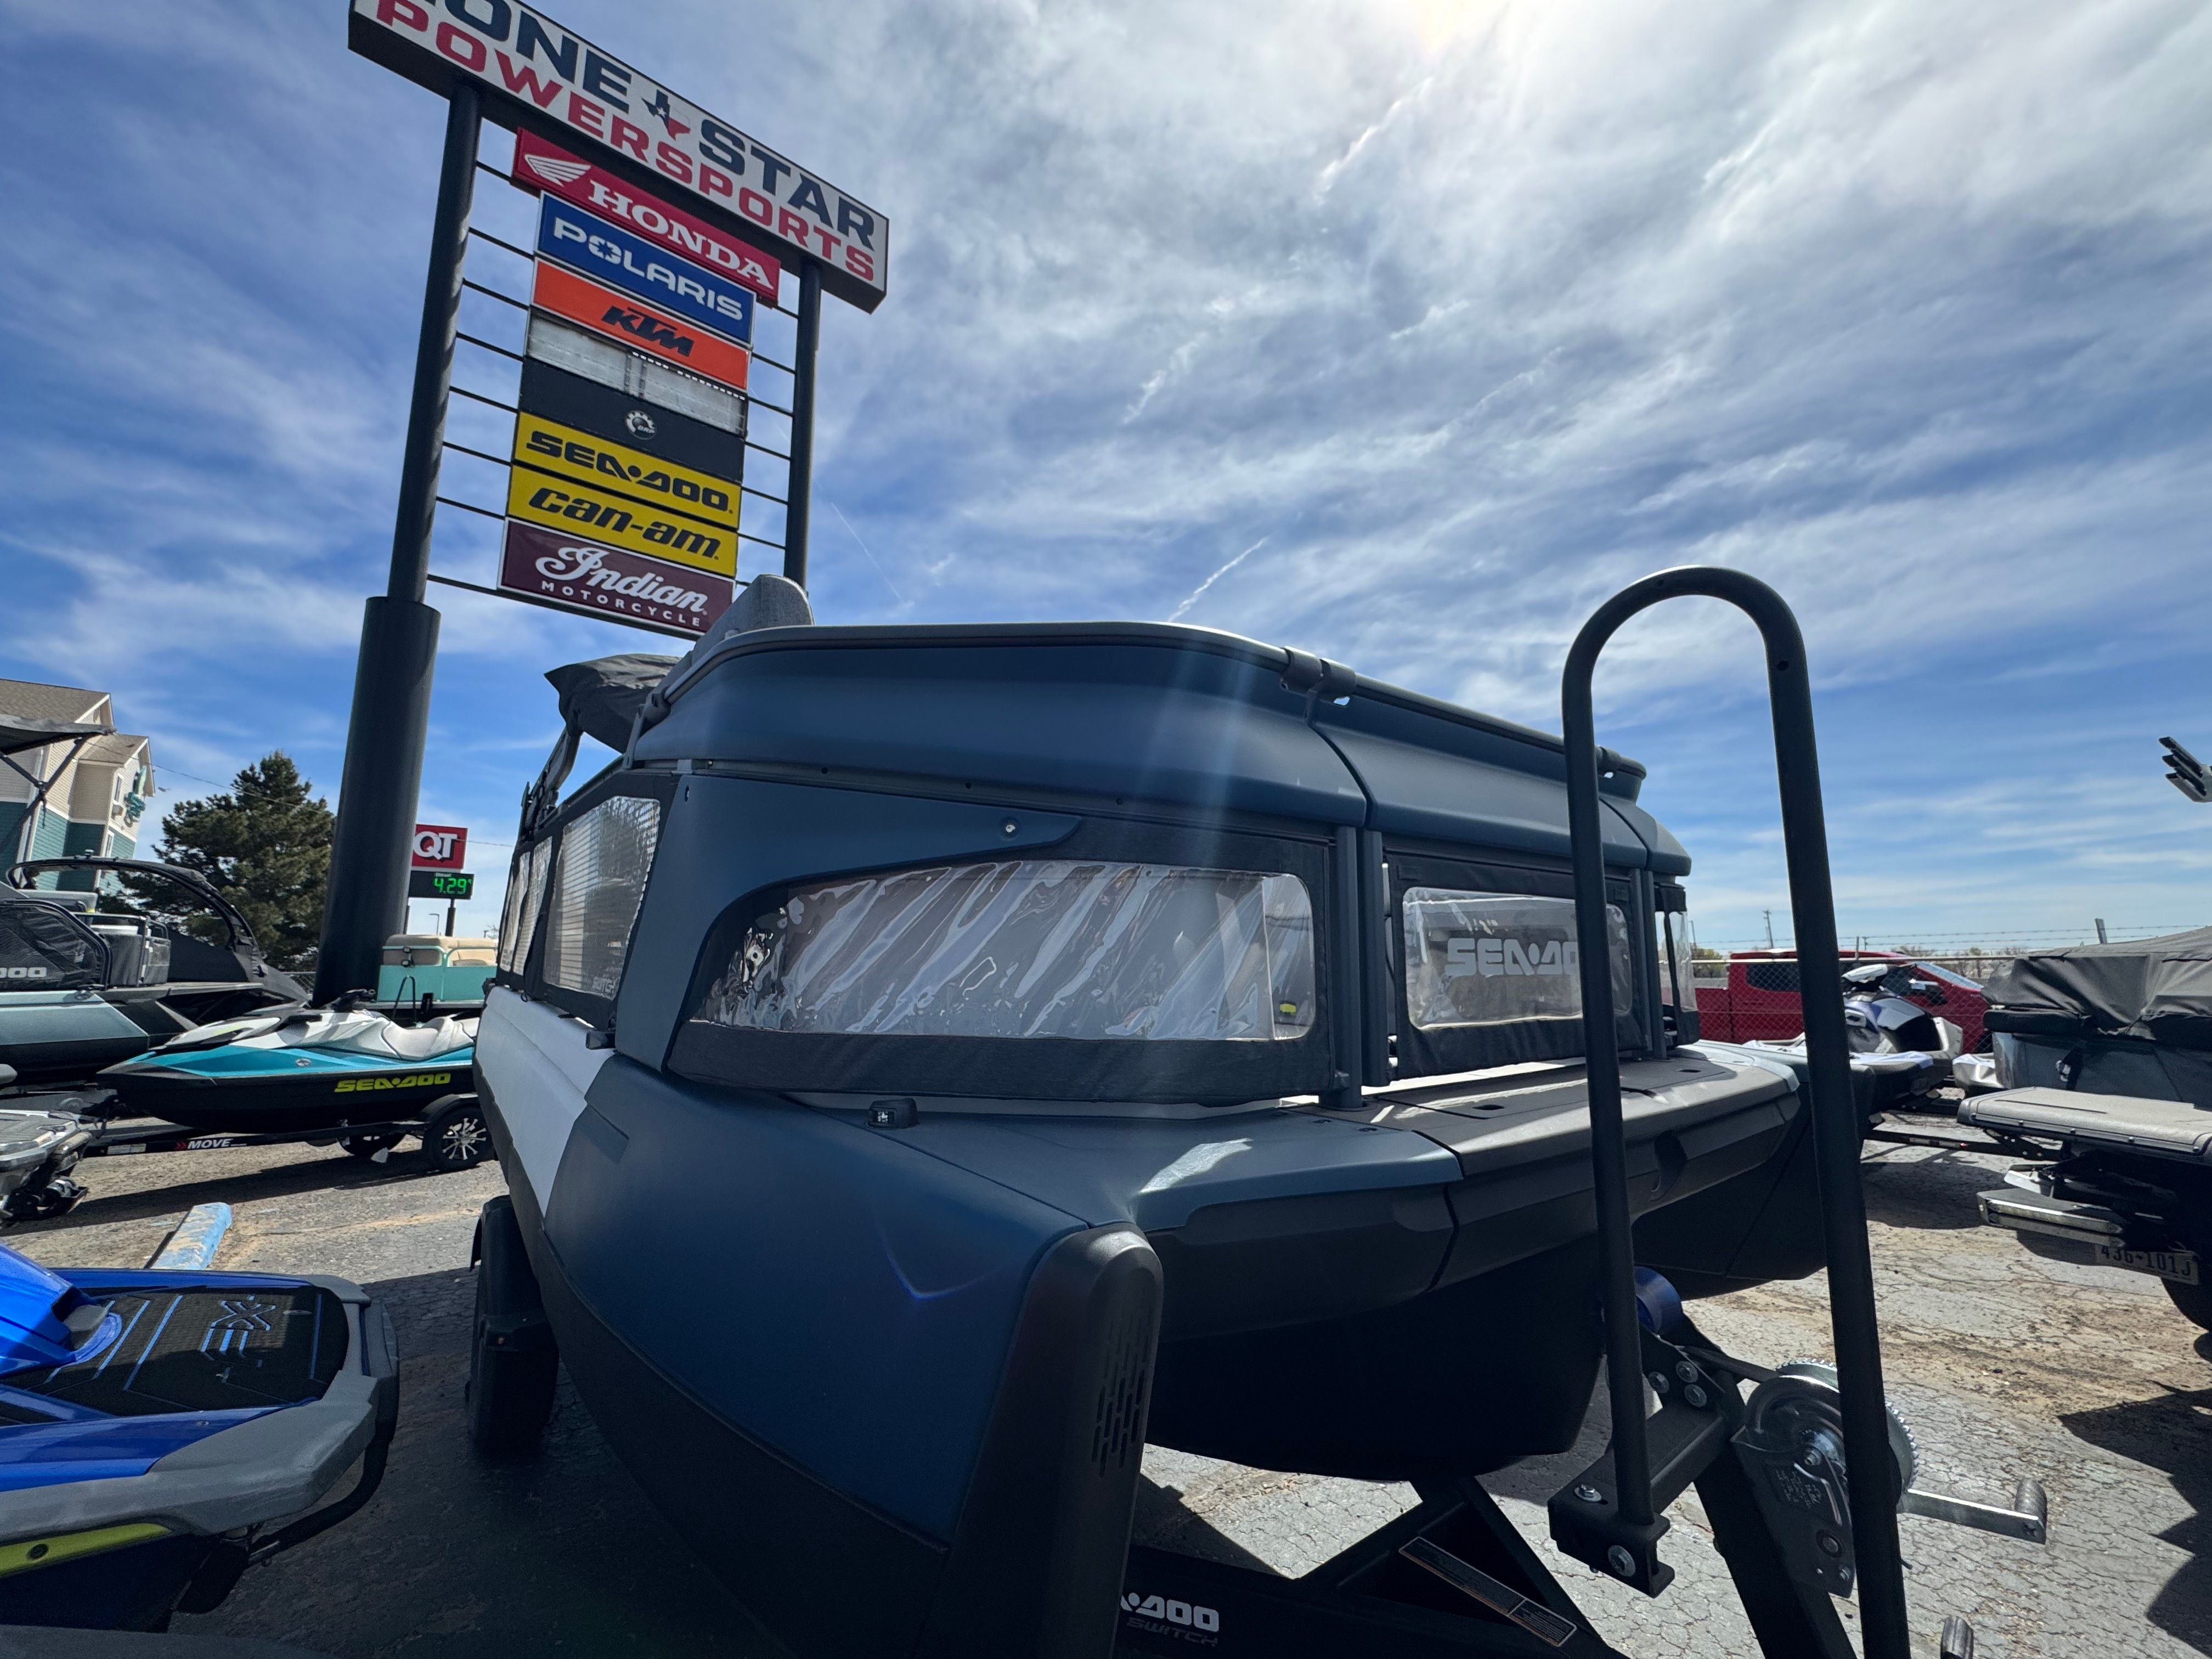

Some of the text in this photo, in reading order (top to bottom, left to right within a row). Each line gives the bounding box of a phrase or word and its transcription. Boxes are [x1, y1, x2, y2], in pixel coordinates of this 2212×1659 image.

[376, 0, 874, 281] POWERSPORTS
[422, 0, 874, 252] ONE STAR
[588, 179, 774, 290] HONDA
[554, 217, 743, 320] POLARIS
[601, 305, 696, 357] KTM
[535, 547, 708, 613] Indian
[541, 580, 701, 627] MOTORCYCLE
[413, 831, 458, 860] QT
[187, 1138, 235, 1150] MOVE
